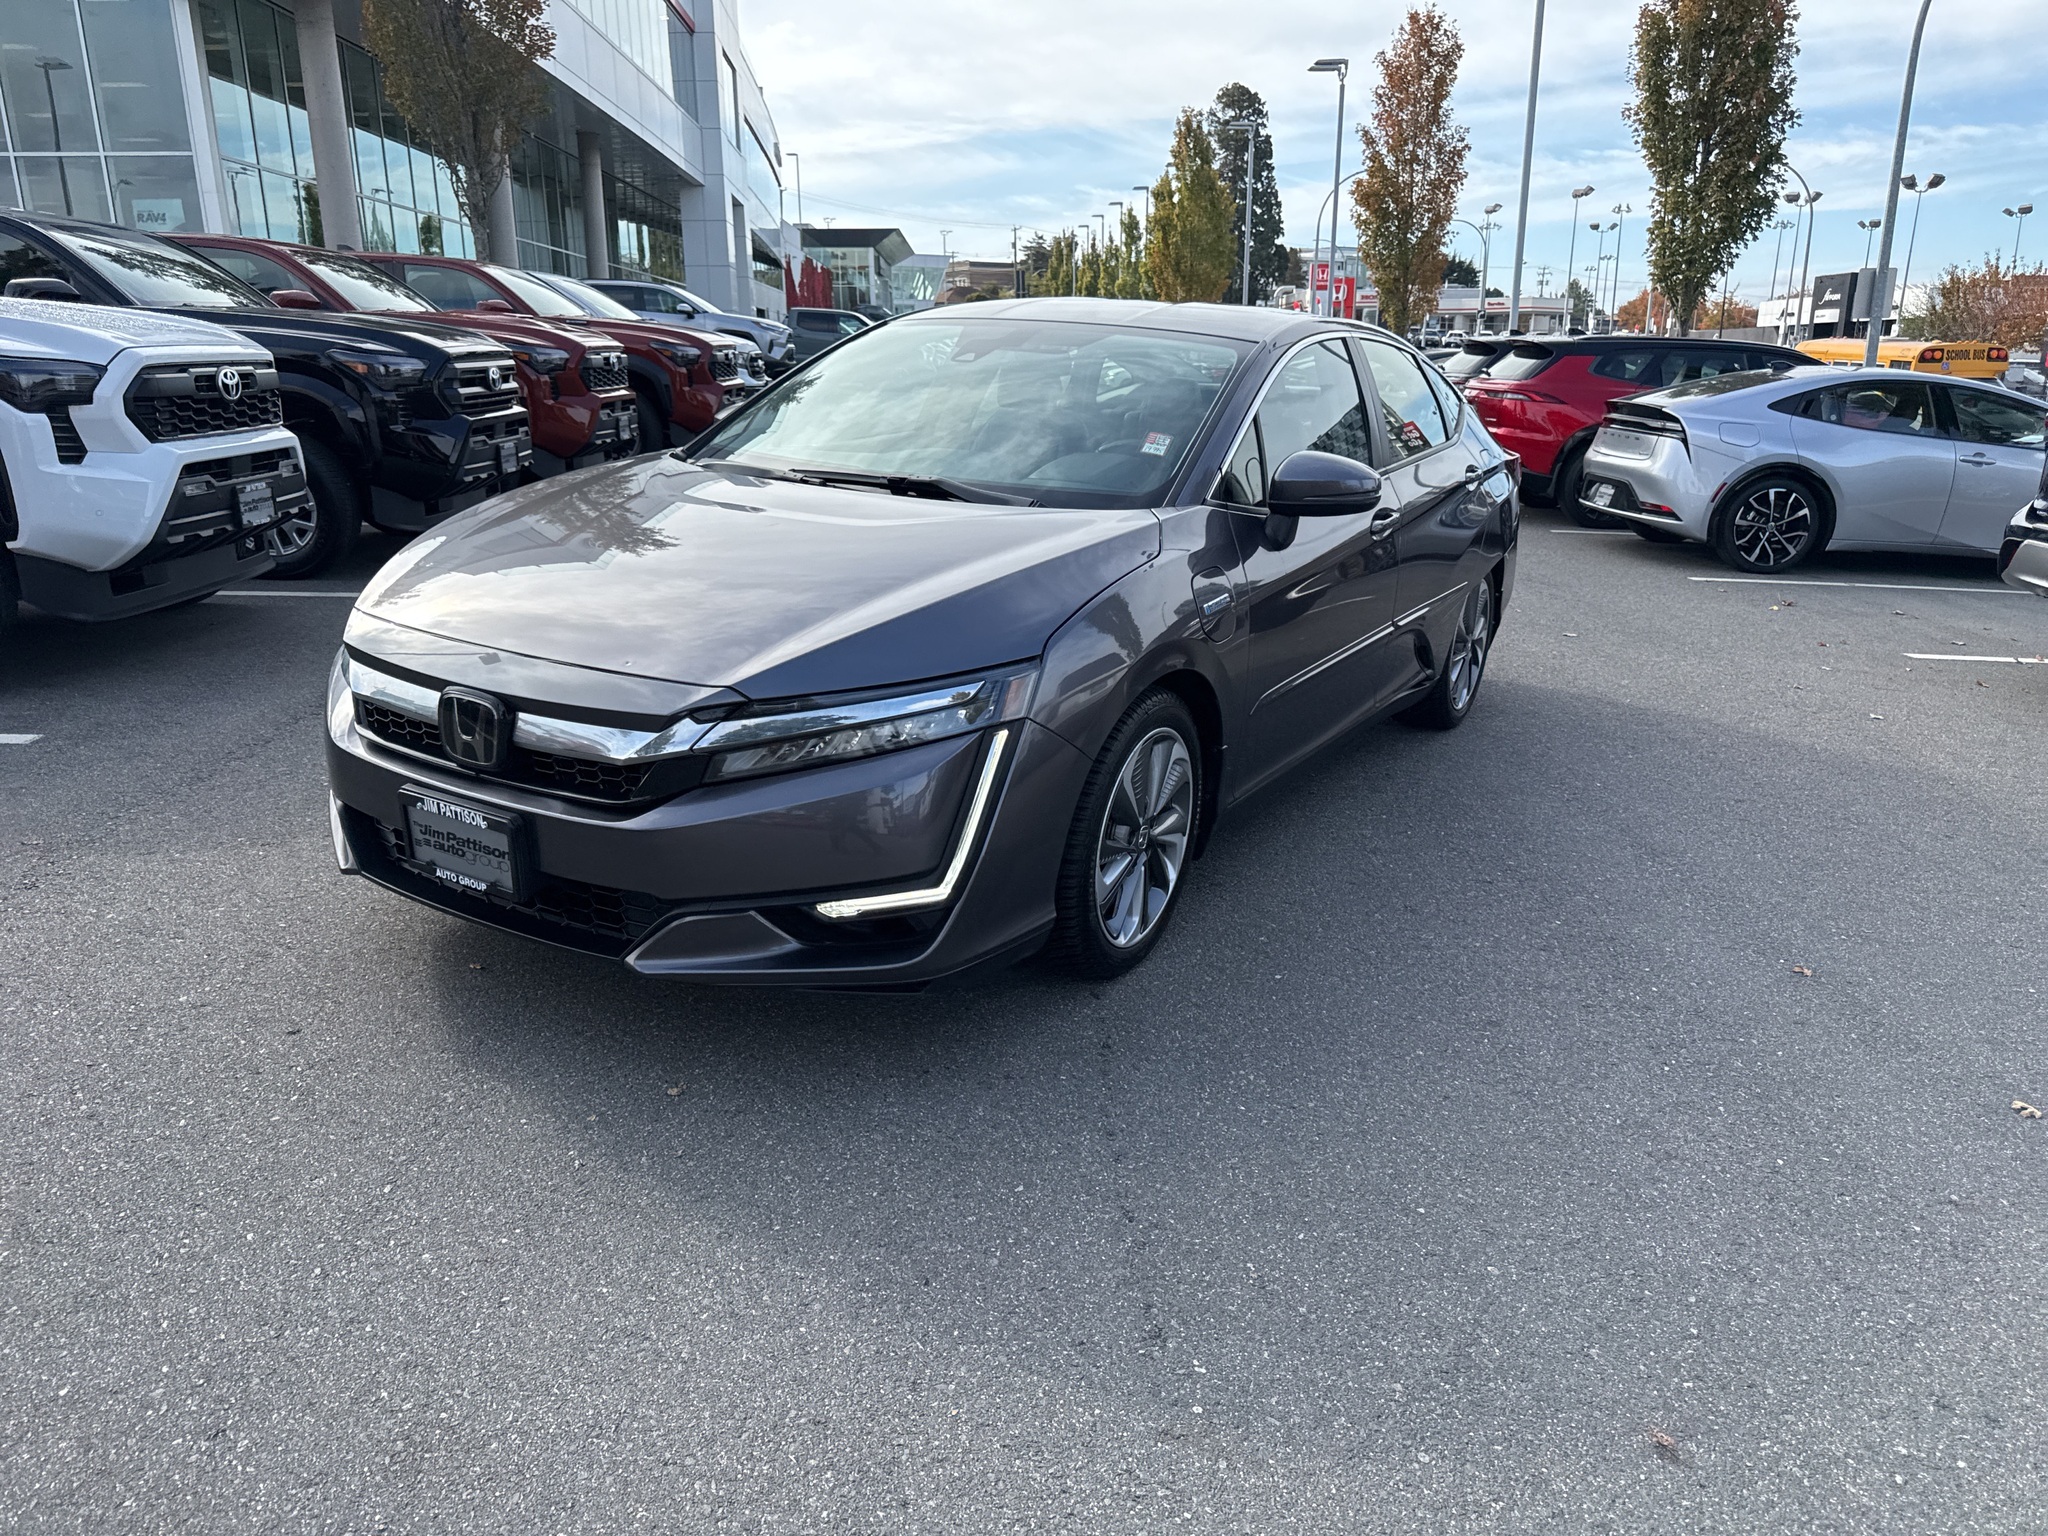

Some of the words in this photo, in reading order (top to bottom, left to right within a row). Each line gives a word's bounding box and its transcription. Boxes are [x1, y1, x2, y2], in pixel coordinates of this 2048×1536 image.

[137, 213, 167, 223] RAV4
[1945, 349, 1971, 361] SCHOOL
[1973, 349, 1986, 360] BUS
[423, 798, 439, 815] JIM
[439, 803, 484, 827] PATTISON
[436, 868, 457, 883] AUTO
[458, 876, 487, 891] GROUP
